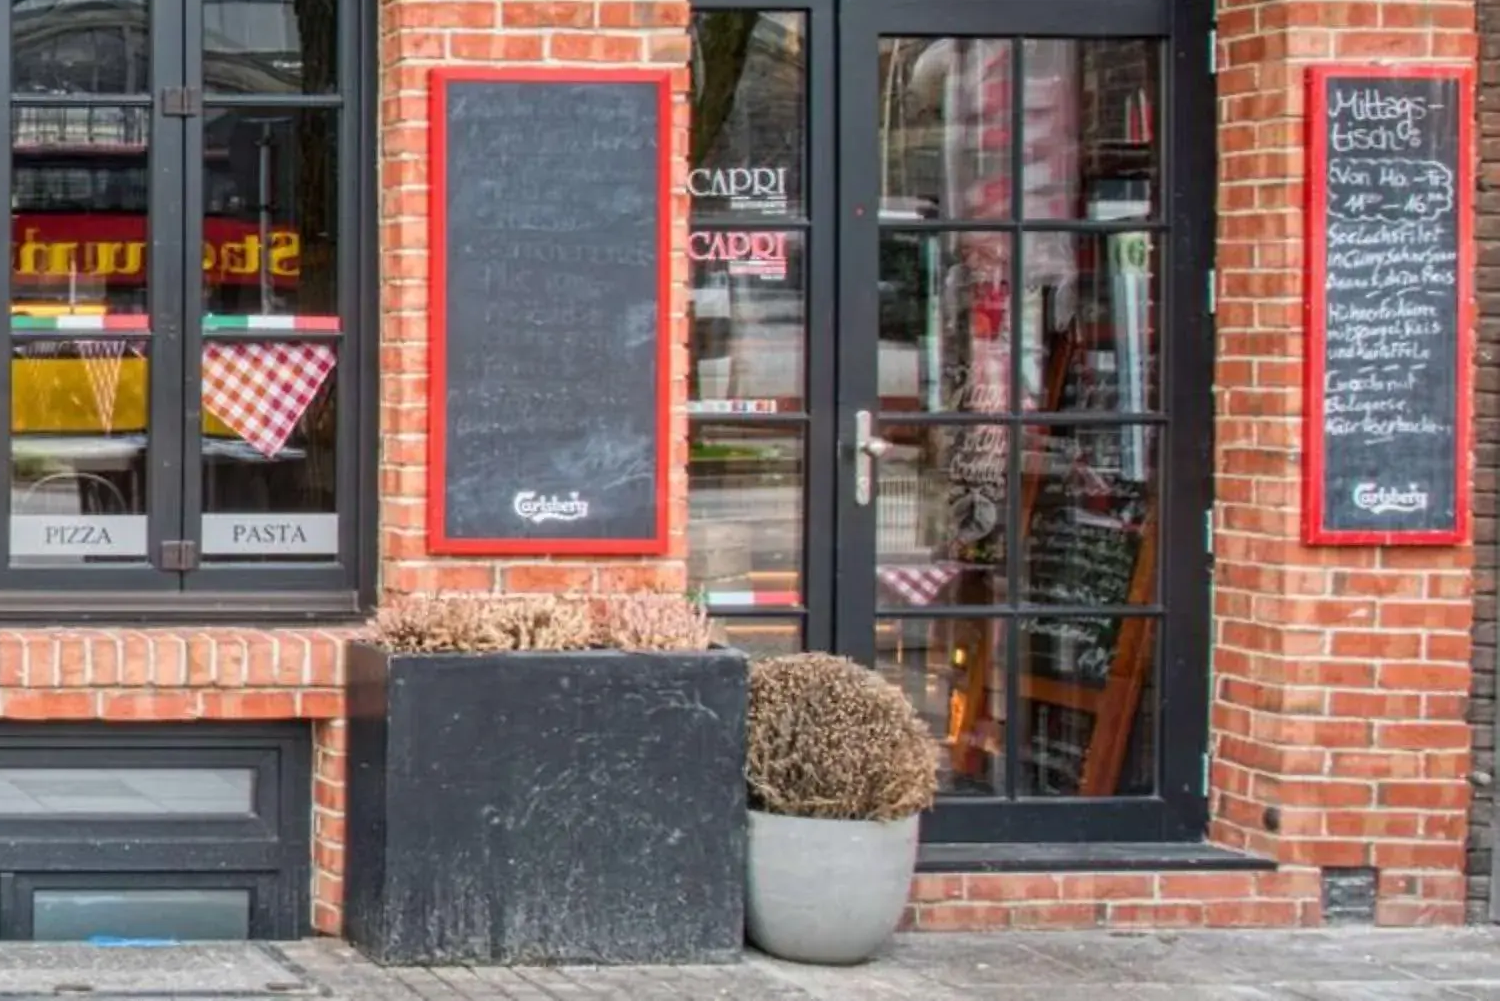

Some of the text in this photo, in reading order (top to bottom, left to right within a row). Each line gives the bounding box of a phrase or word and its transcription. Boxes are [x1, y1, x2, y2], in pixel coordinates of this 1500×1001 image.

[687, 167, 787, 196] CAPRI
[688, 231, 787, 261] CAPRI
[513, 491, 589, 525] Carlsberg
[1353, 483, 1428, 514] Carlsberg
[44, 525, 112, 544] PIZZA
[232, 524, 306, 544] PASTA
